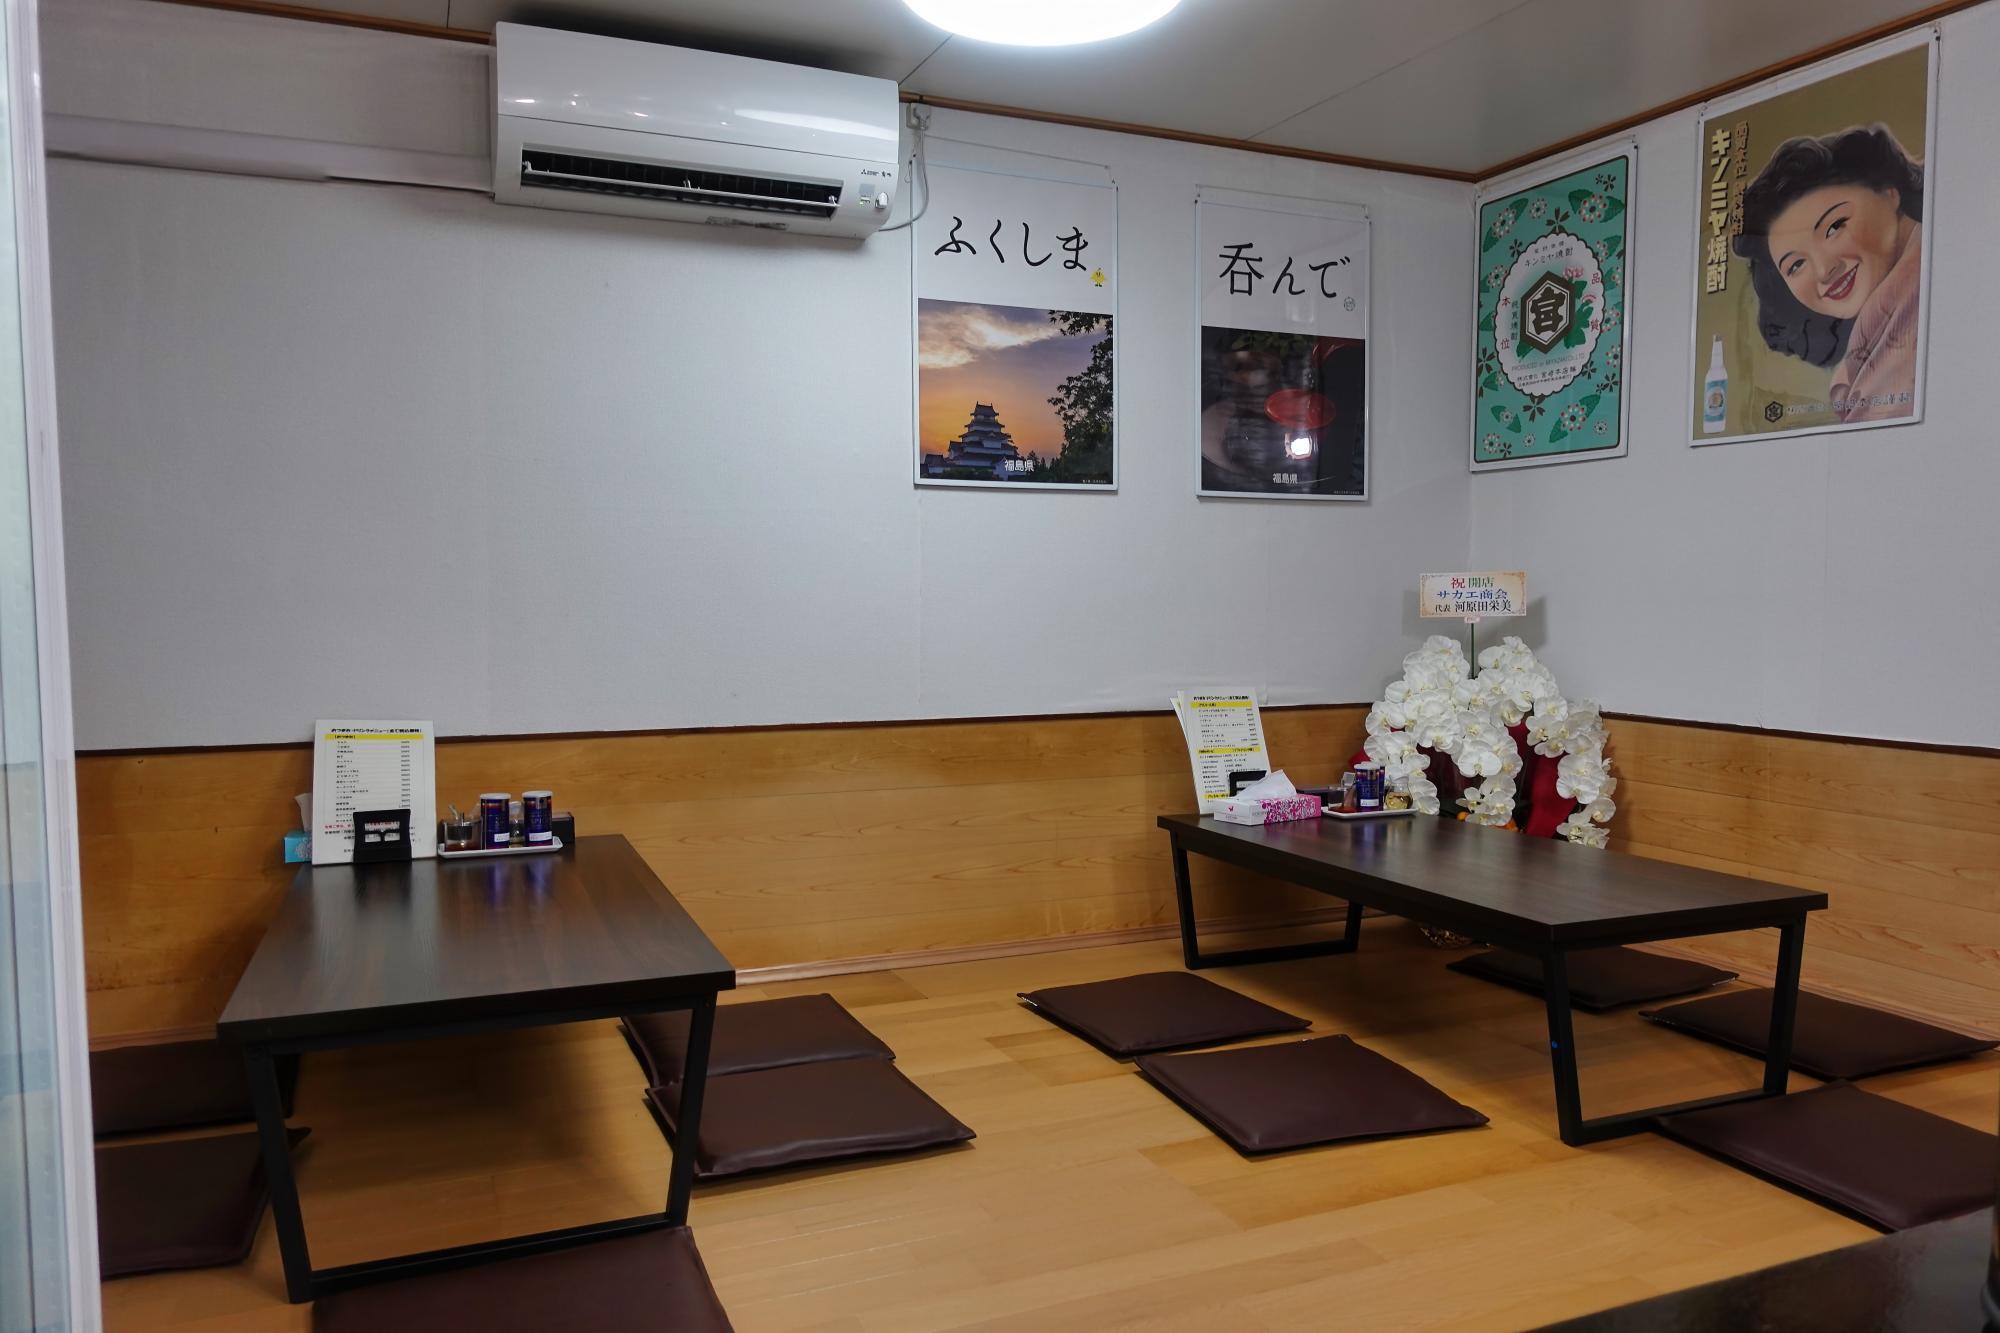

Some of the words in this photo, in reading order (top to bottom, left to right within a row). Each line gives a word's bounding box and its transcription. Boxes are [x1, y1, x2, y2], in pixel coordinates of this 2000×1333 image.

[1706, 128, 1732, 295] キンミヤ焼酎
[934, 215, 1089, 272] ふくしま
[1218, 241, 1351, 298] 呑んで
[1004, 459, 1034, 472] 福島県
[1273, 473, 1298, 484] 福島県
[1451, 577, 1466, 589] 祝
[1468, 576, 1495, 588] 開店
[1437, 588, 1508, 600] サカエ商会
[1435, 604, 1451, 613] 代表
[1455, 599, 1511, 612] 河原田栄美
